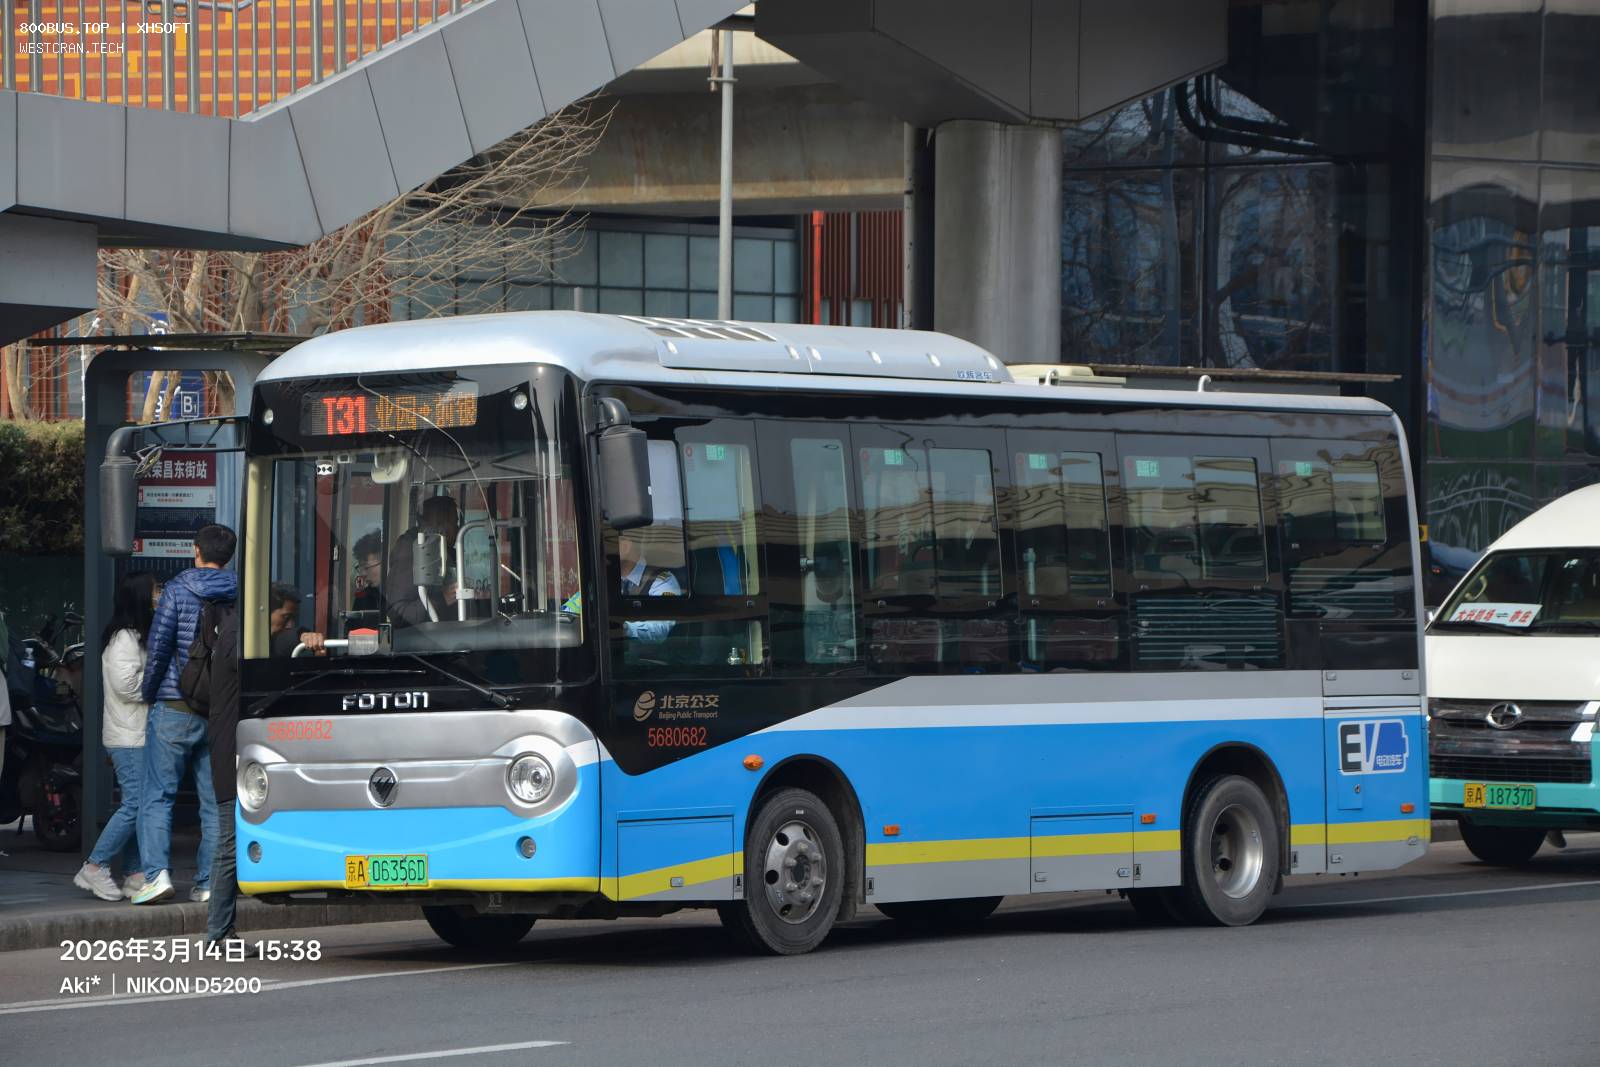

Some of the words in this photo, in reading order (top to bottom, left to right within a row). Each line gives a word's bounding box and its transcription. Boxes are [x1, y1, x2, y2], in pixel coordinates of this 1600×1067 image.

[321, 395, 367, 435] T31
[342, 691, 429, 711] FOTON
[659, 694, 720, 709] 北京公交
[658, 711, 677, 720] Beijing
[677, 711, 692, 719] Public
[692, 711, 719, 719] Transport
[266, 719, 334, 742] 5680682
[647, 726, 708, 747] 5680682
[1340, 721, 1380, 773] EV
